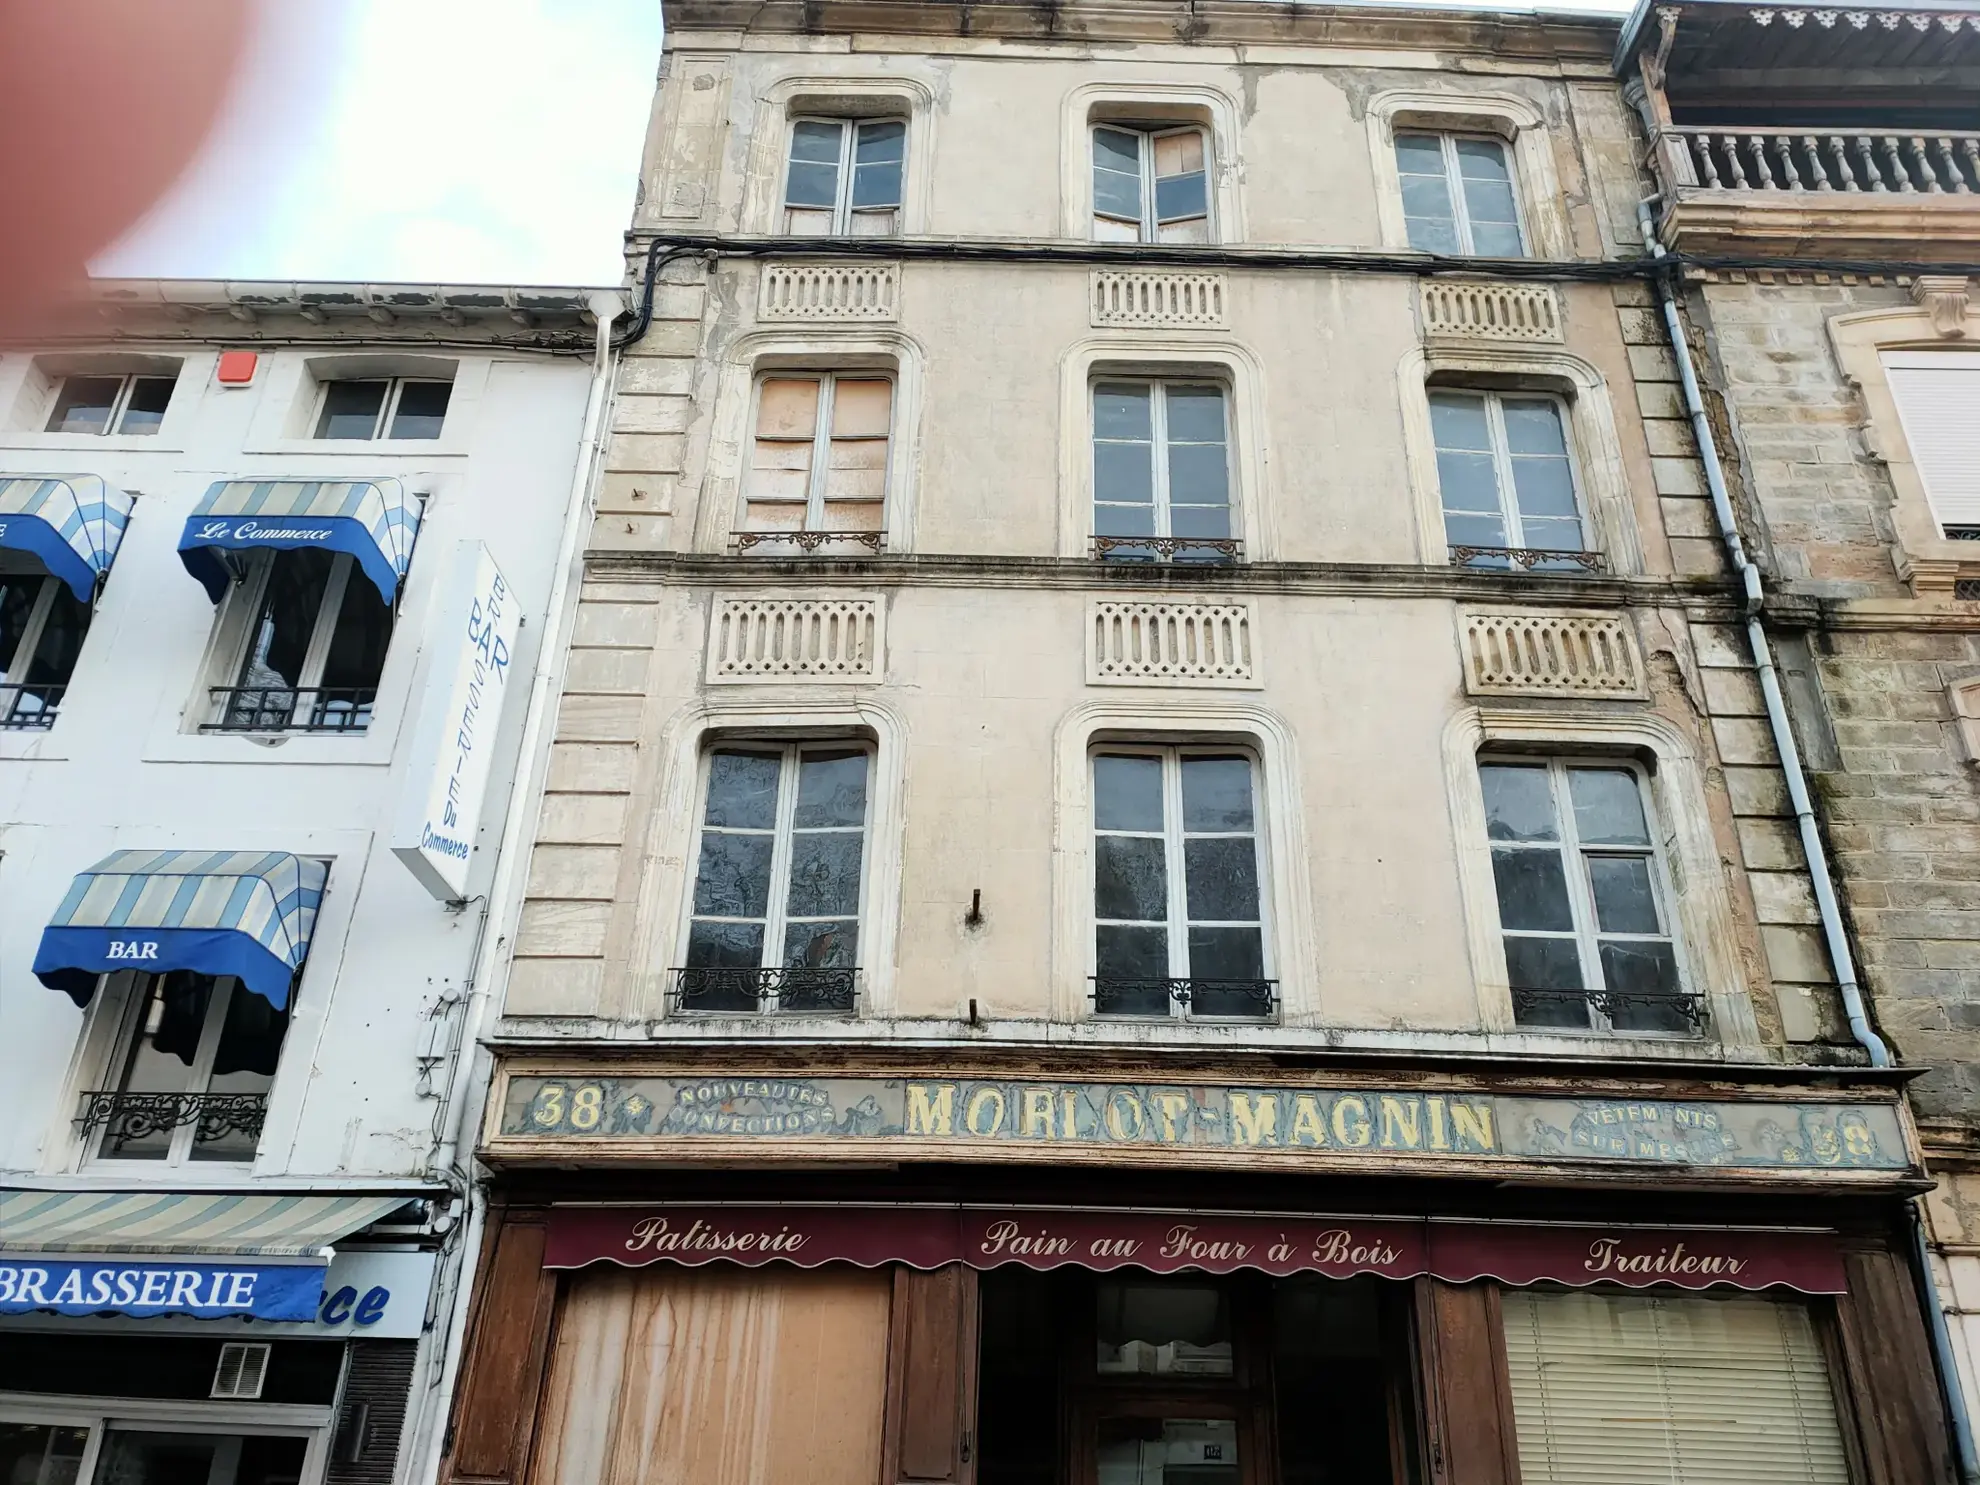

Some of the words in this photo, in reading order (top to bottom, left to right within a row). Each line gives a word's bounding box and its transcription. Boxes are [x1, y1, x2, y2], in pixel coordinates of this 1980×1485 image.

[194, 521, 230, 539] Le
[234, 521, 333, 540] Commerce
[467, 597, 509, 685] BAR
[443, 800, 458, 829] Du
[421, 821, 469, 859] Commerce
[105, 941, 158, 959] BAR
[534, 1085, 601, 1129] 38
[625, 1216, 811, 1251] Patisserie
[981, 1220, 1078, 1256] Pain
[1090, 1237, 1144, 1258] au
[1159, 1225, 1255, 1260] Four
[1268, 1234, 1298, 1262] à
[1312, 1229, 1403, 1265] Bois
[1584, 1238, 1748, 1275] Traiteur
[0, 1267, 258, 1307] BRASSERIE
